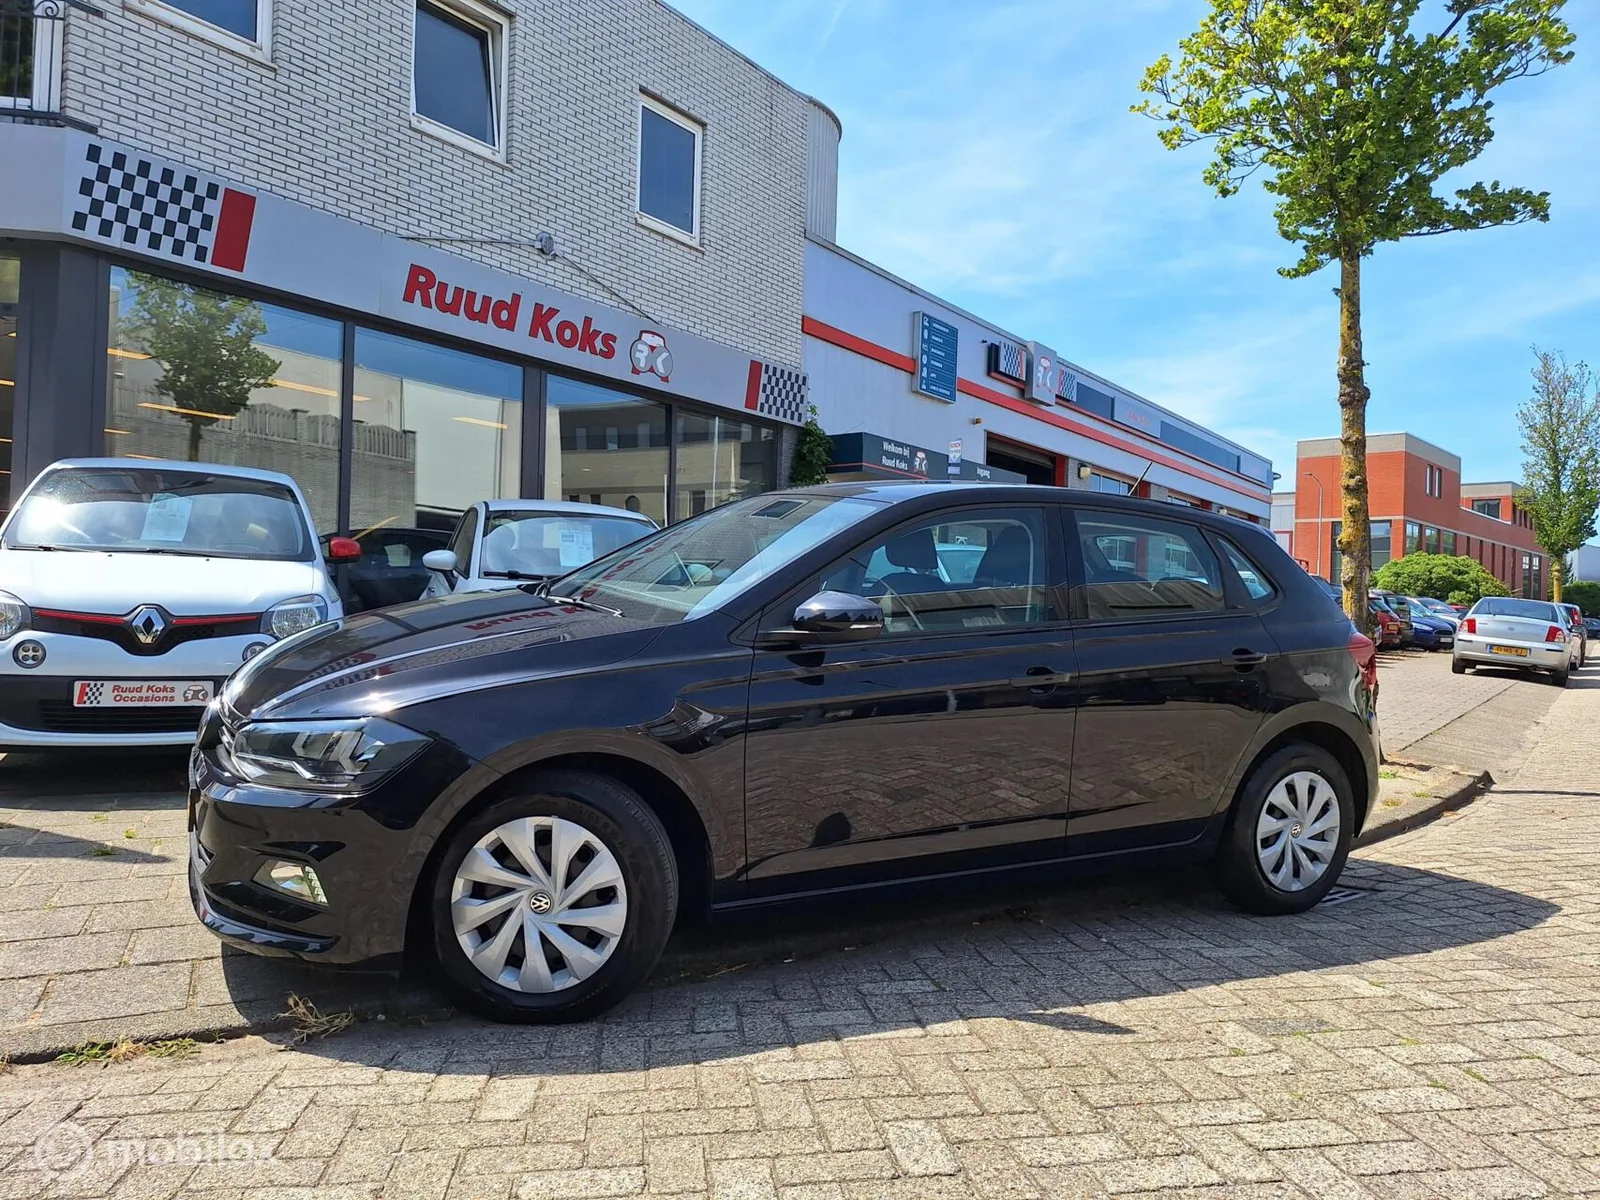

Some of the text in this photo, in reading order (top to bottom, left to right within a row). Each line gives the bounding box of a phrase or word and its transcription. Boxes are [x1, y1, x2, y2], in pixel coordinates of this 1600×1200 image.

[402, 263, 617, 360] Ruud Koks
[882, 441, 903, 455] Welkom
[881, 456, 908, 471] Ruud Koks
[112, 685, 176, 693] Ruud Koks
[113, 694, 175, 702] Occasions
